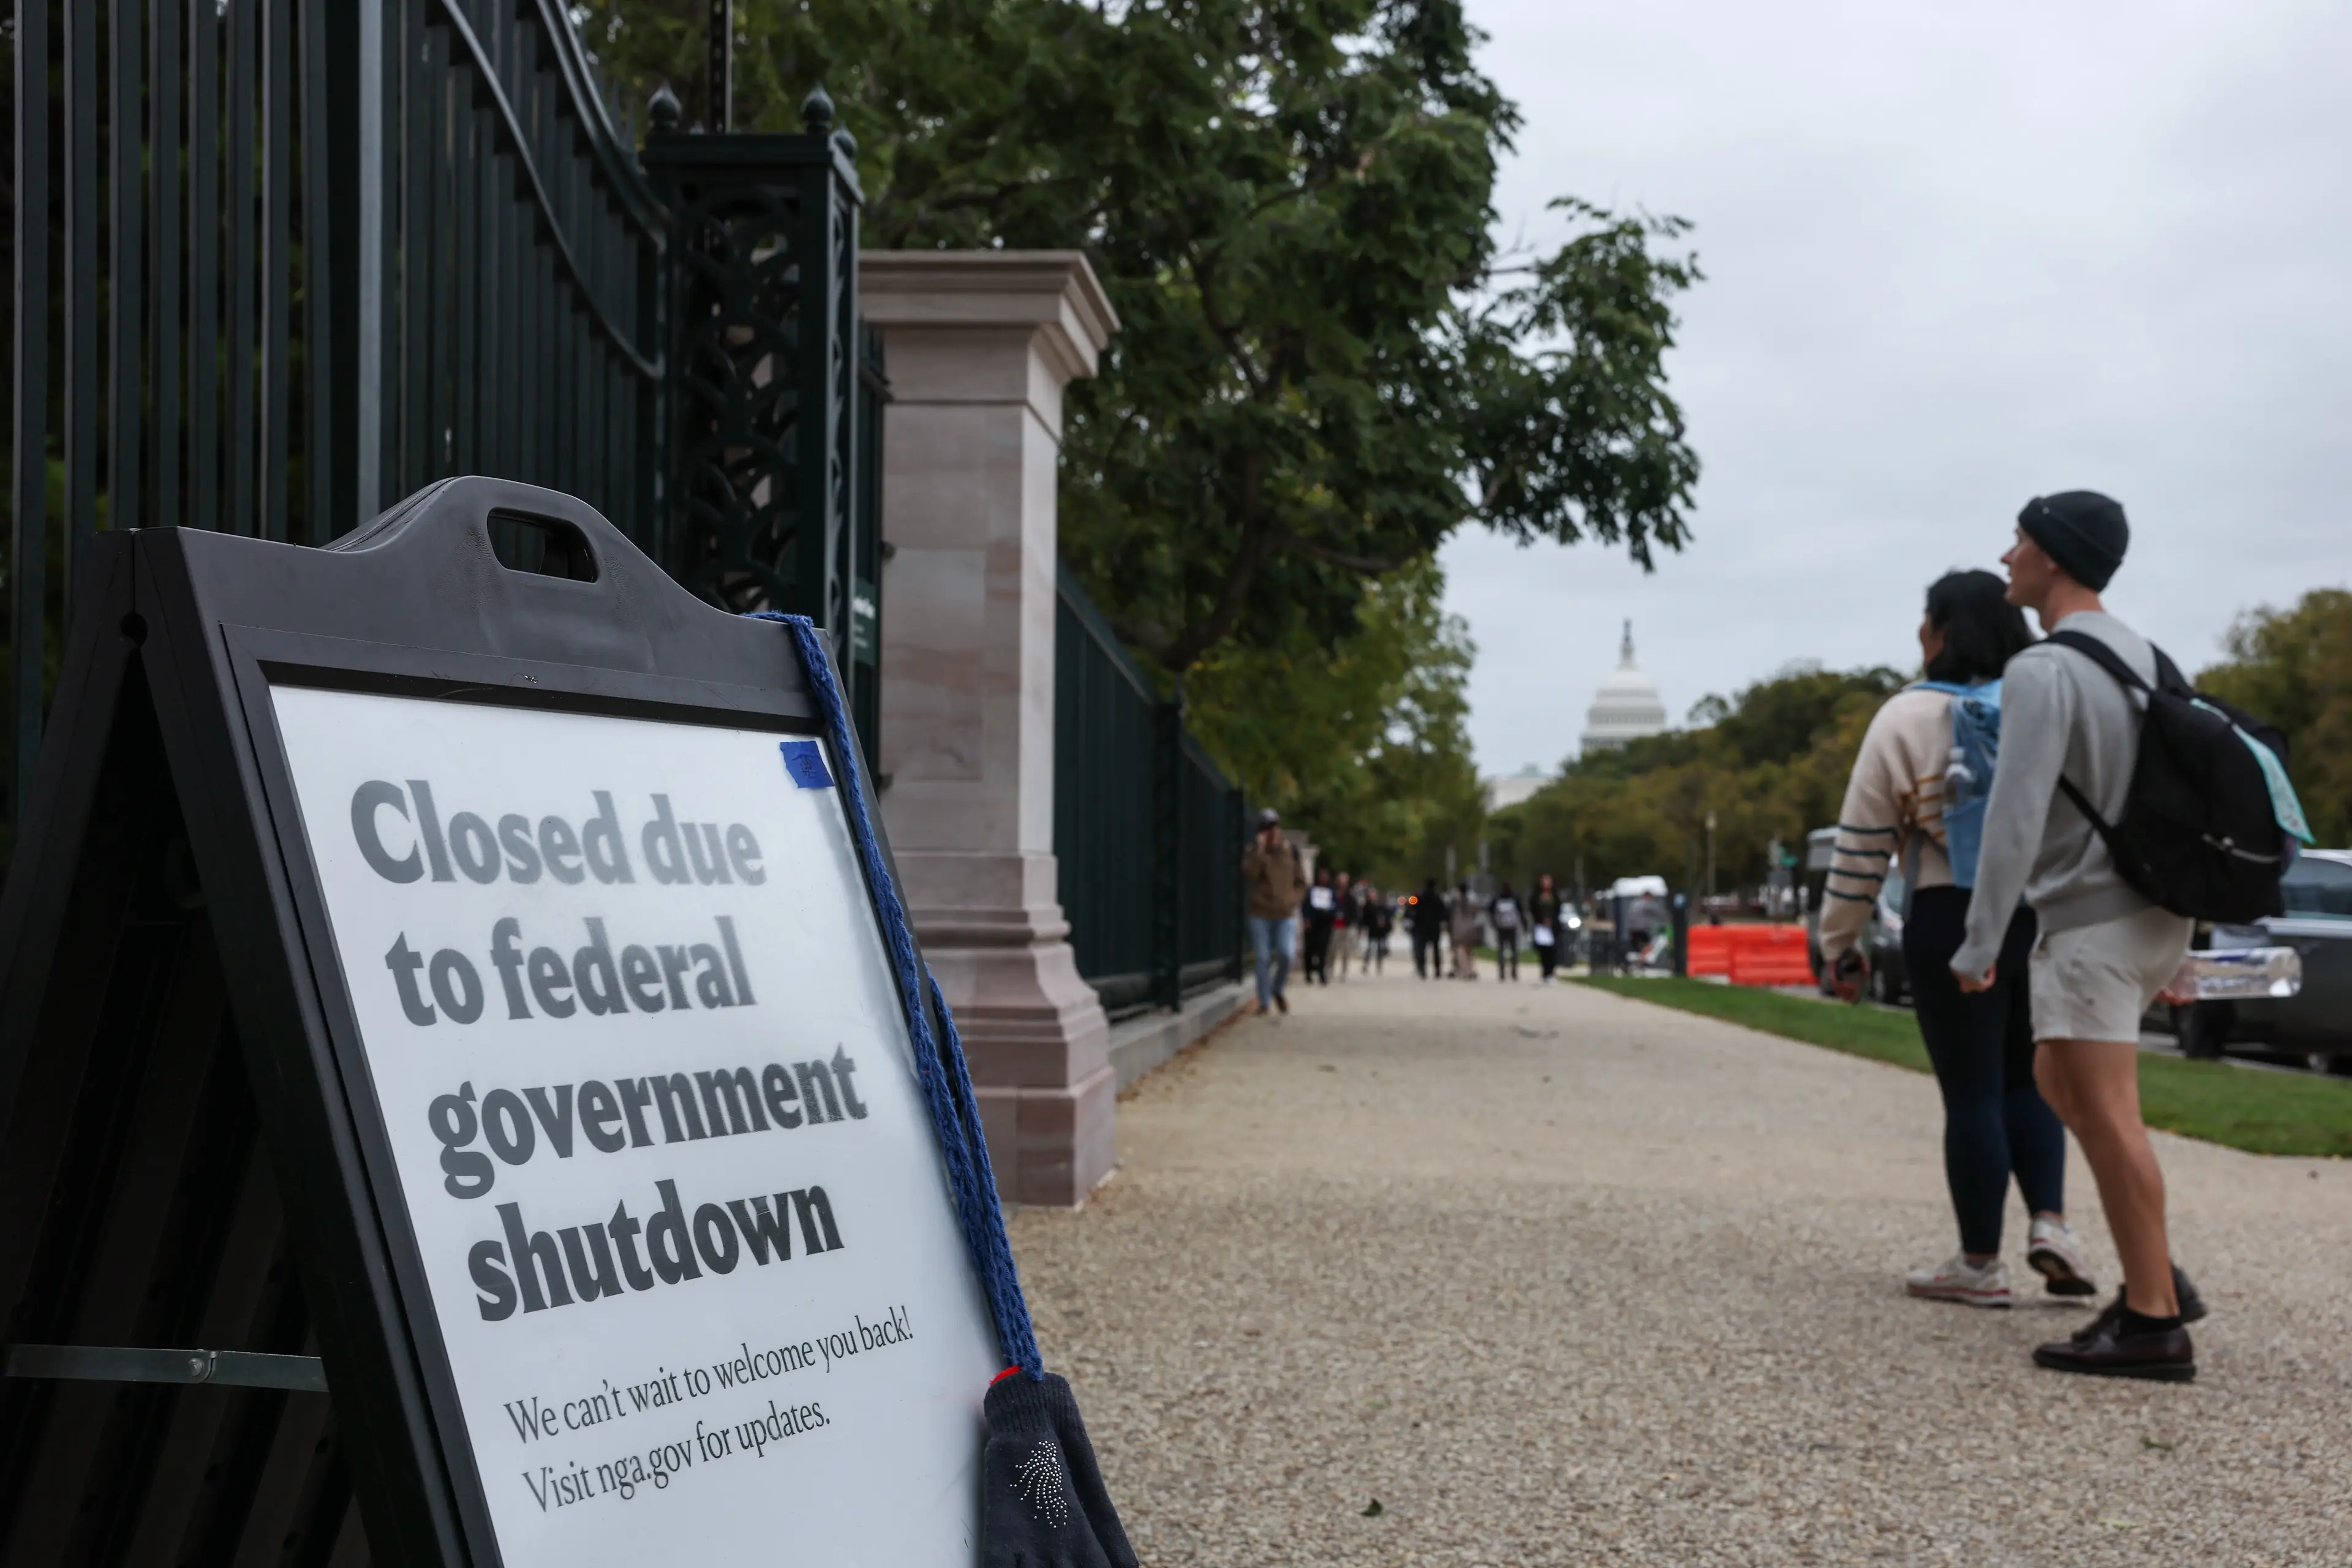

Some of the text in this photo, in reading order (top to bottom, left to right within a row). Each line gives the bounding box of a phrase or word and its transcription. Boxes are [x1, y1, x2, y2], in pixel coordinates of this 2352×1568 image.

[350, 780, 767, 886] Closed due
[385, 916, 758, 1027] to federal
[428, 1041, 869, 1200] government
[467, 1178, 845, 1322] shutdown
[503, 1305, 913, 1444] We can’t wait to welcome you back!
[522, 1400, 832, 1513] Visit nga.gov for updates.
